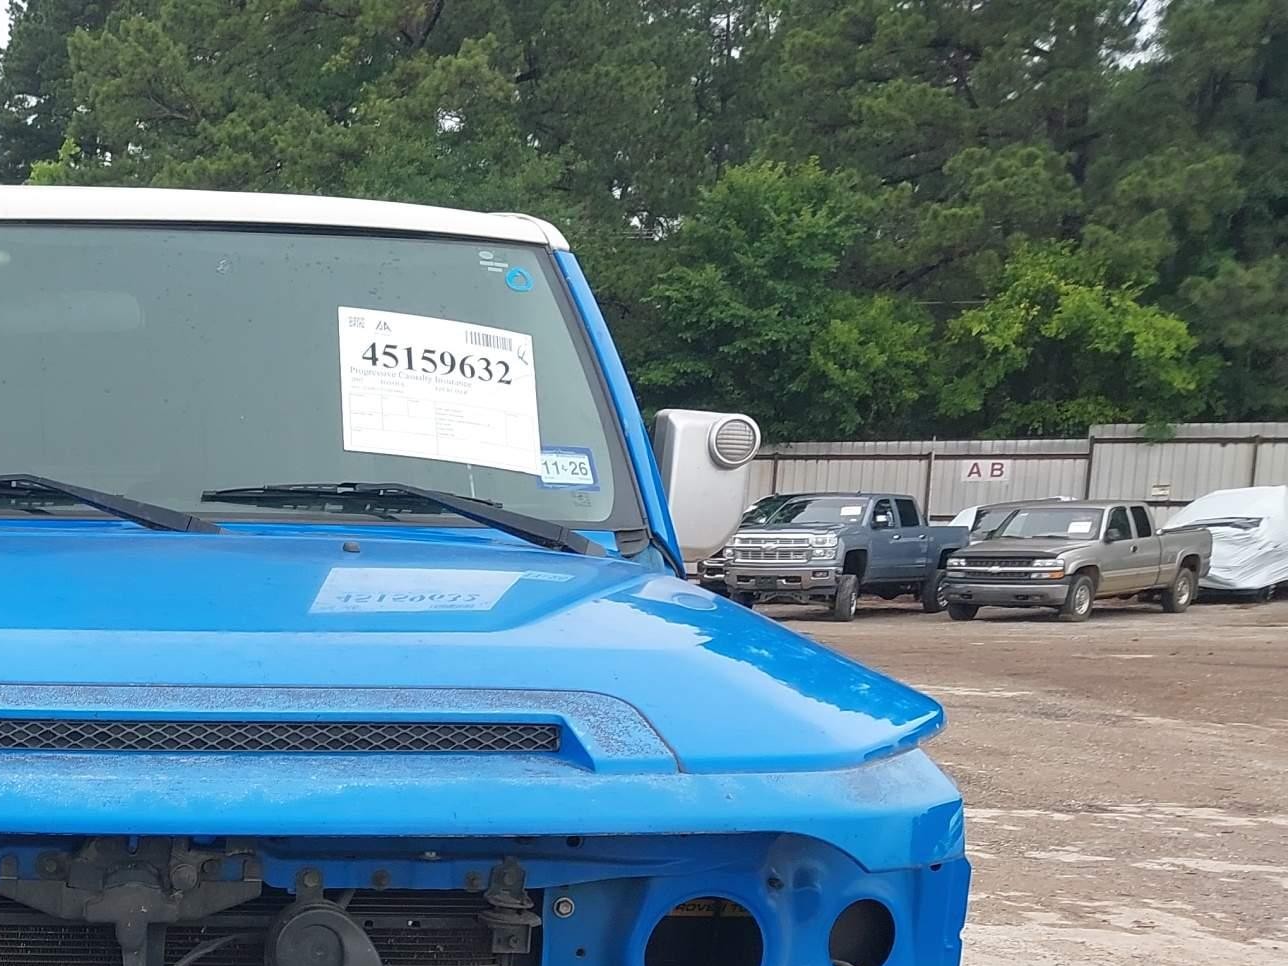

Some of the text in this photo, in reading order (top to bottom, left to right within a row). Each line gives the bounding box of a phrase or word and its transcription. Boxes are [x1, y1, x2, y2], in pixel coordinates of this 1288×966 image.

[362, 342, 513, 385] 45159632
[350, 365, 396, 379] Progressive
[398, 371, 433, 384] Casualty
[435, 375, 472, 388] Insurance
[967, 462, 1005, 478] A B
